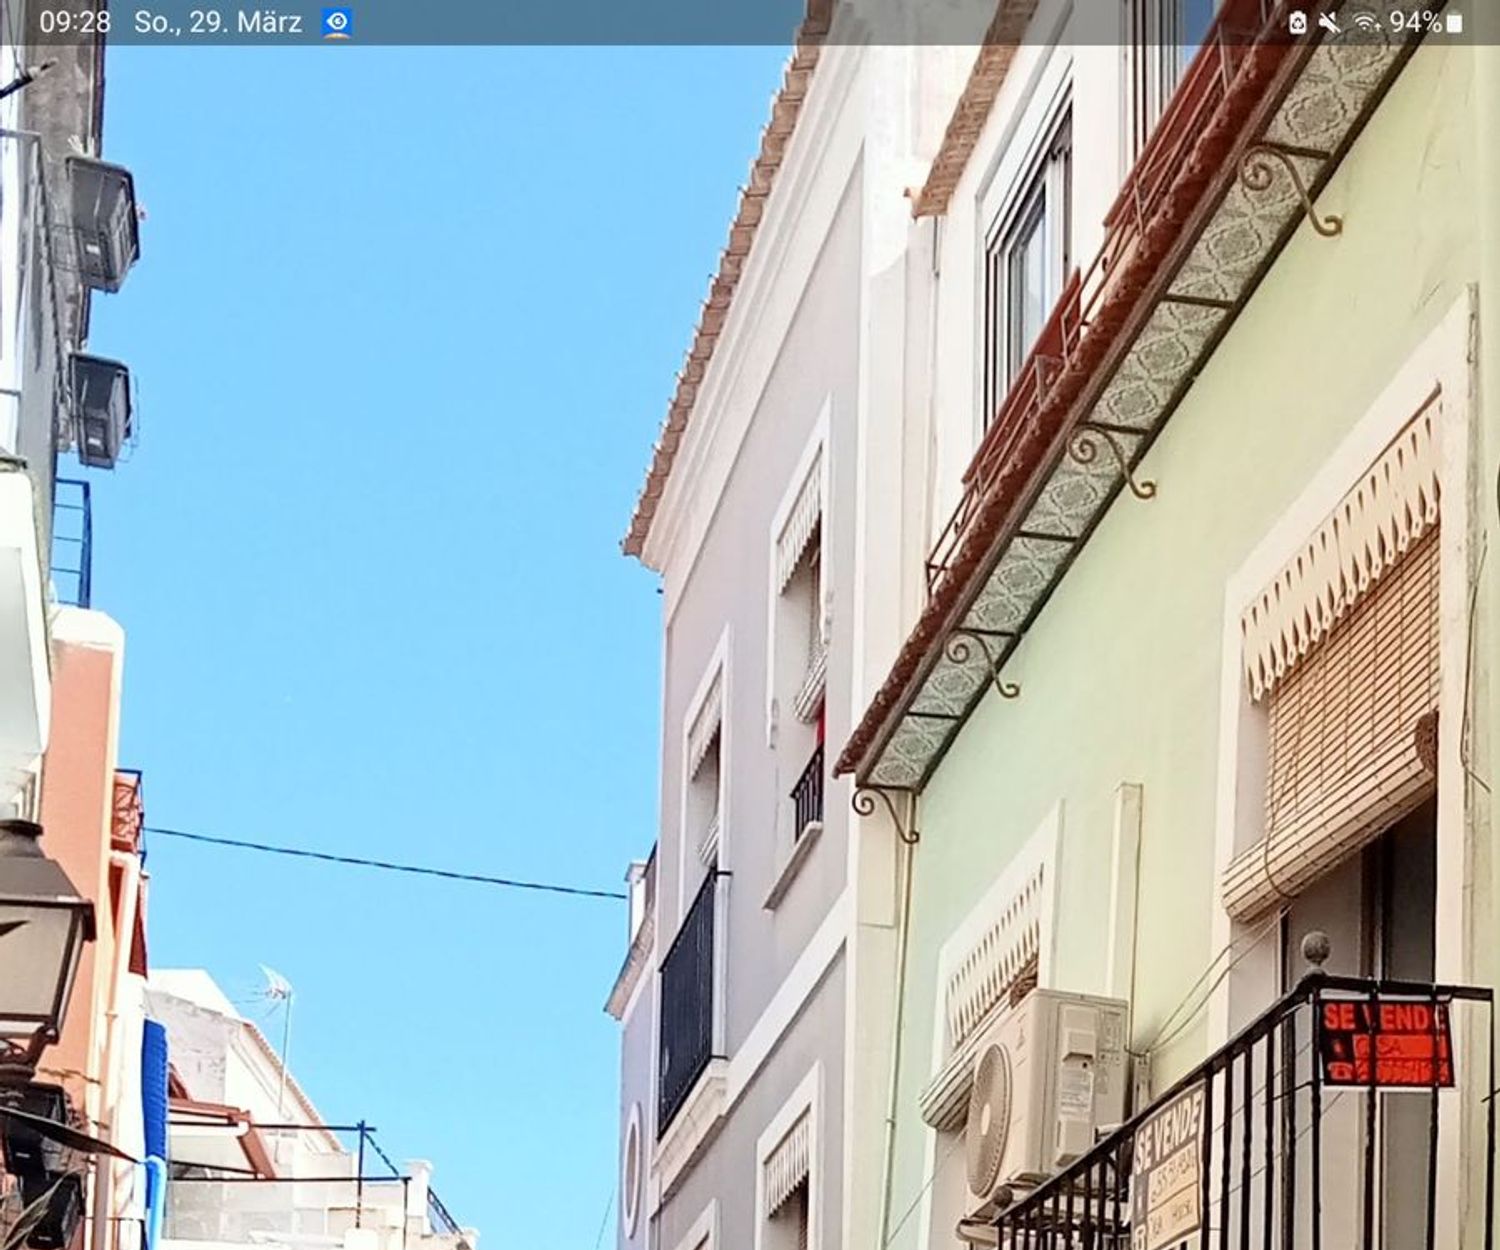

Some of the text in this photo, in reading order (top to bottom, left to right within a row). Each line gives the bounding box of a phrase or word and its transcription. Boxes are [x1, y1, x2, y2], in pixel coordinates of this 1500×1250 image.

[1324, 1003, 1355, 1030] SE
[1136, 1125, 1152, 1175] SE
[1154, 1092, 1202, 1162] VENDE
